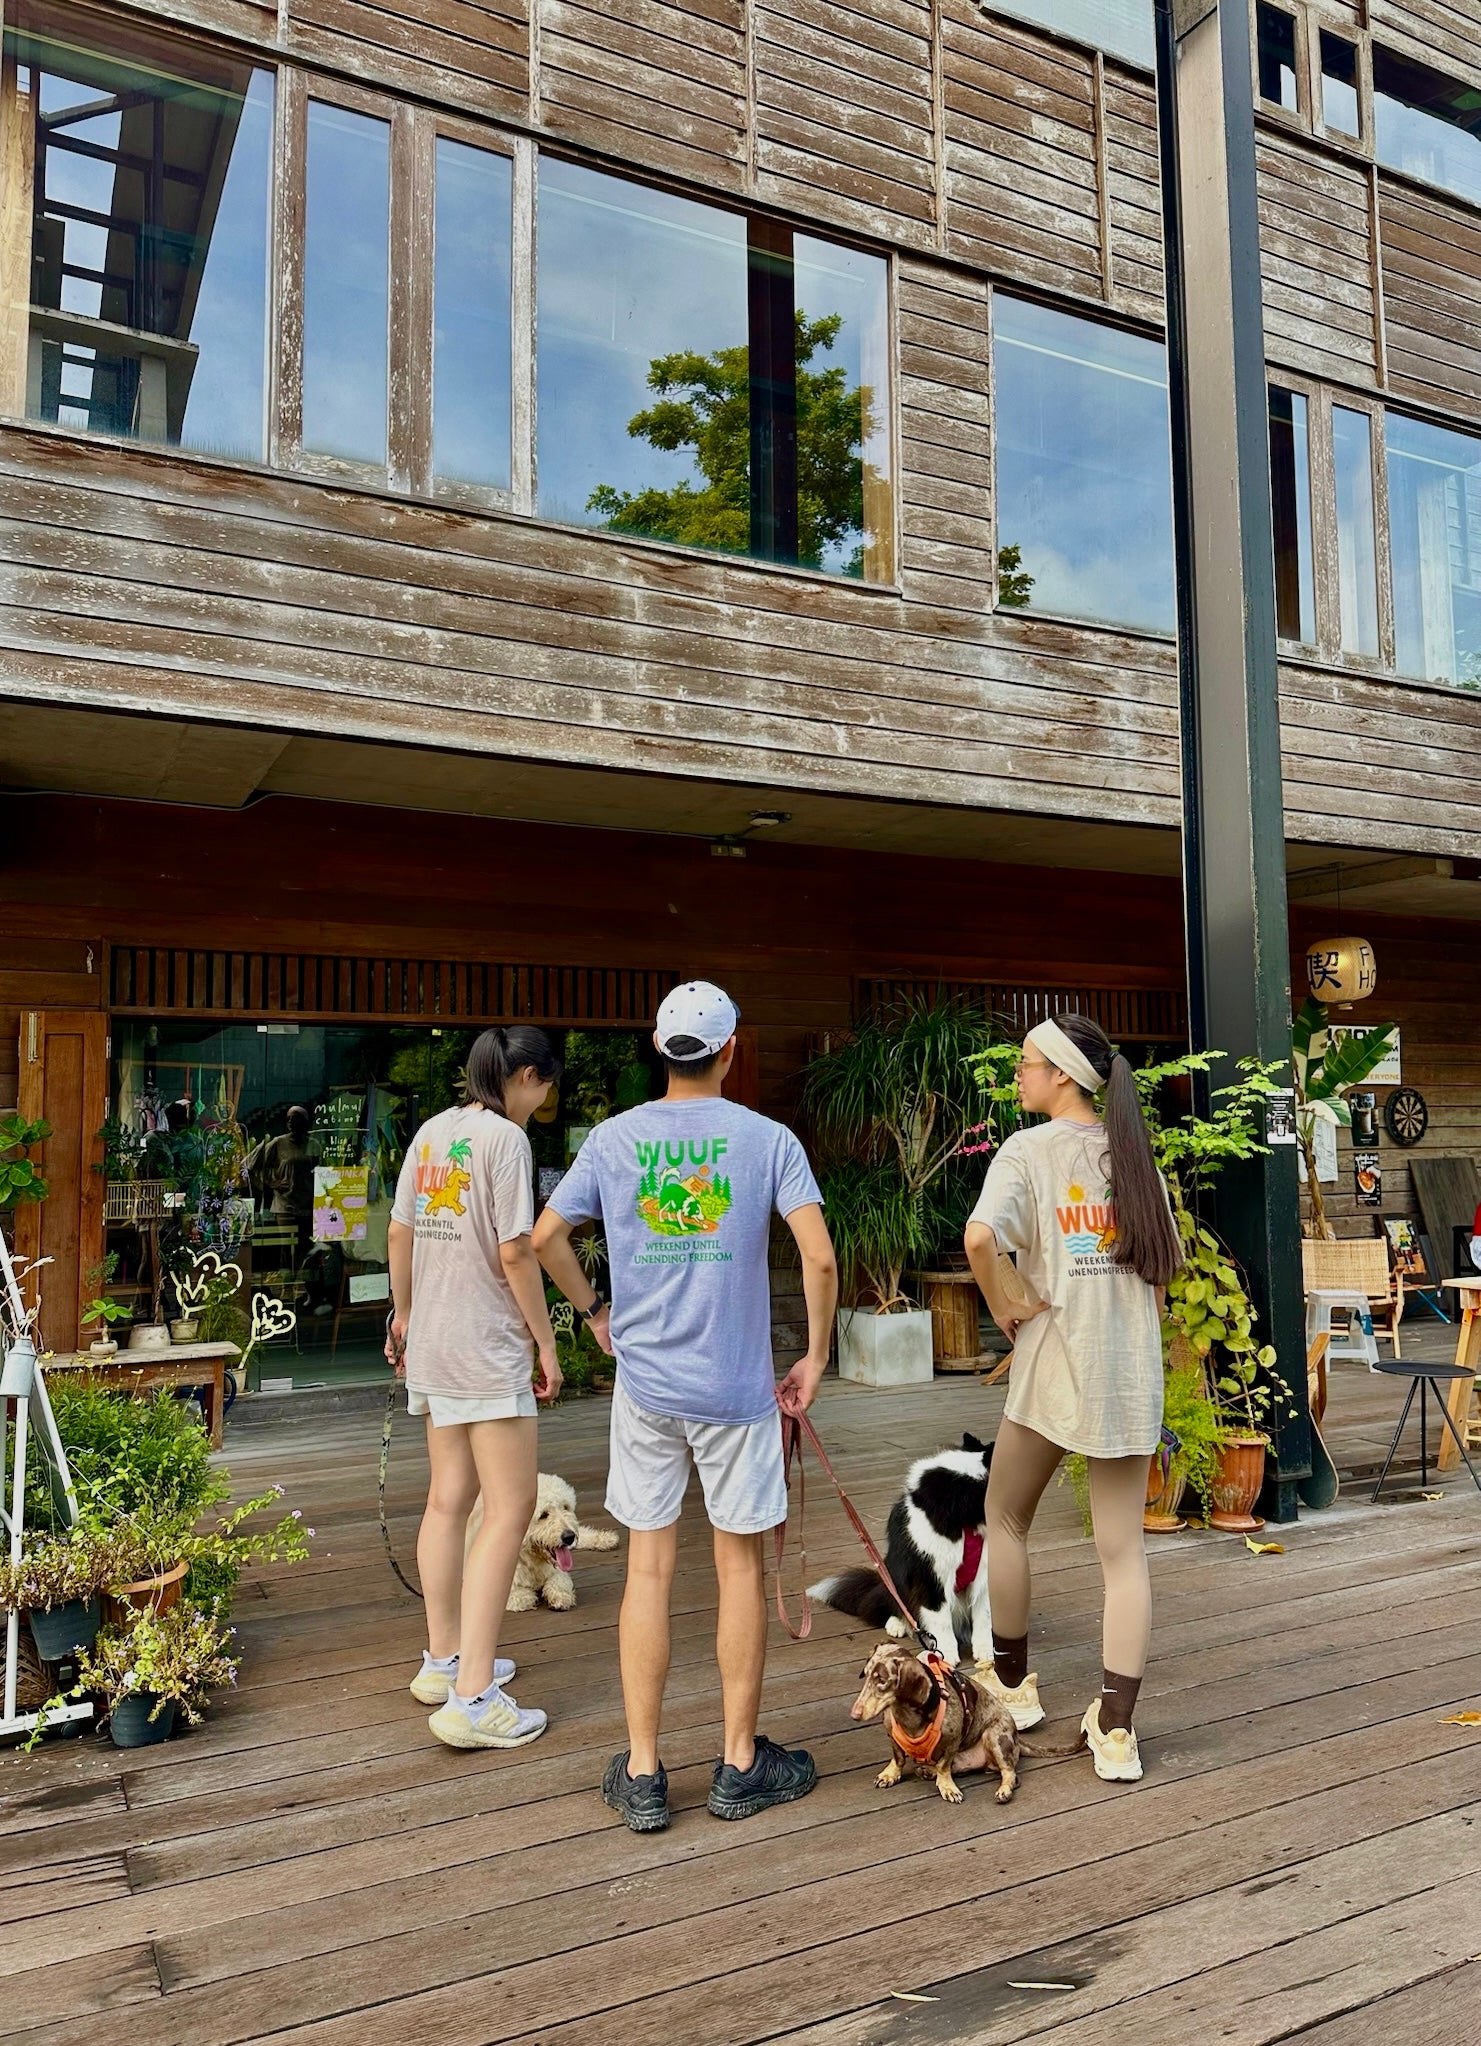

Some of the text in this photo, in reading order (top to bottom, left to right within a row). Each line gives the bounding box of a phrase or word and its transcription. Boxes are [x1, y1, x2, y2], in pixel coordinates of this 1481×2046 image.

[635, 1137, 728, 1167] WUUF
[1055, 1204, 1117, 1235] WUU
[645, 1239, 721, 1252] WEEKEND UNTIL
[634, 1251, 733, 1265] UNENDING FREEDOM
[1112, 1266, 1135, 1275] FREED
